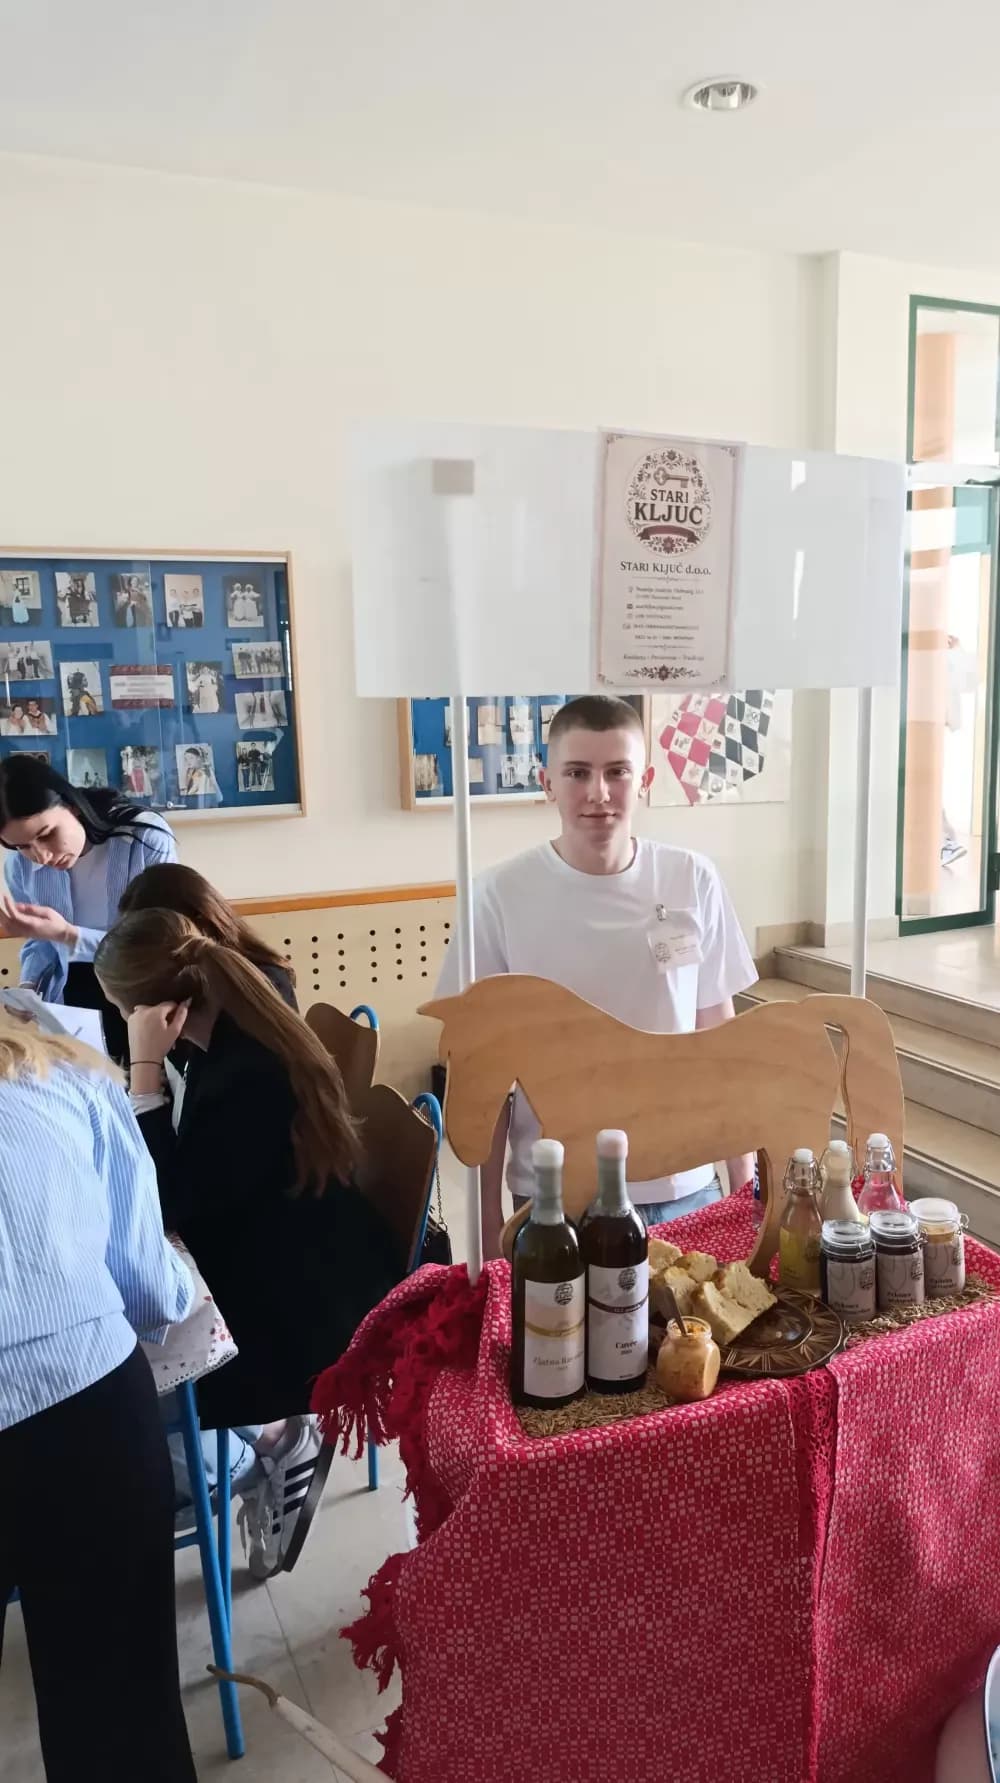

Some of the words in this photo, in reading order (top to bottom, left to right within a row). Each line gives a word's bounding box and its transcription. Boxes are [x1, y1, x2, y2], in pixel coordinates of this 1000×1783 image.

[650, 488, 689, 504] STARI
[620, 560, 649, 572] STARI
[652, 561, 683, 575] KLJUČ
[685, 564, 712, 576] d.o.o.
